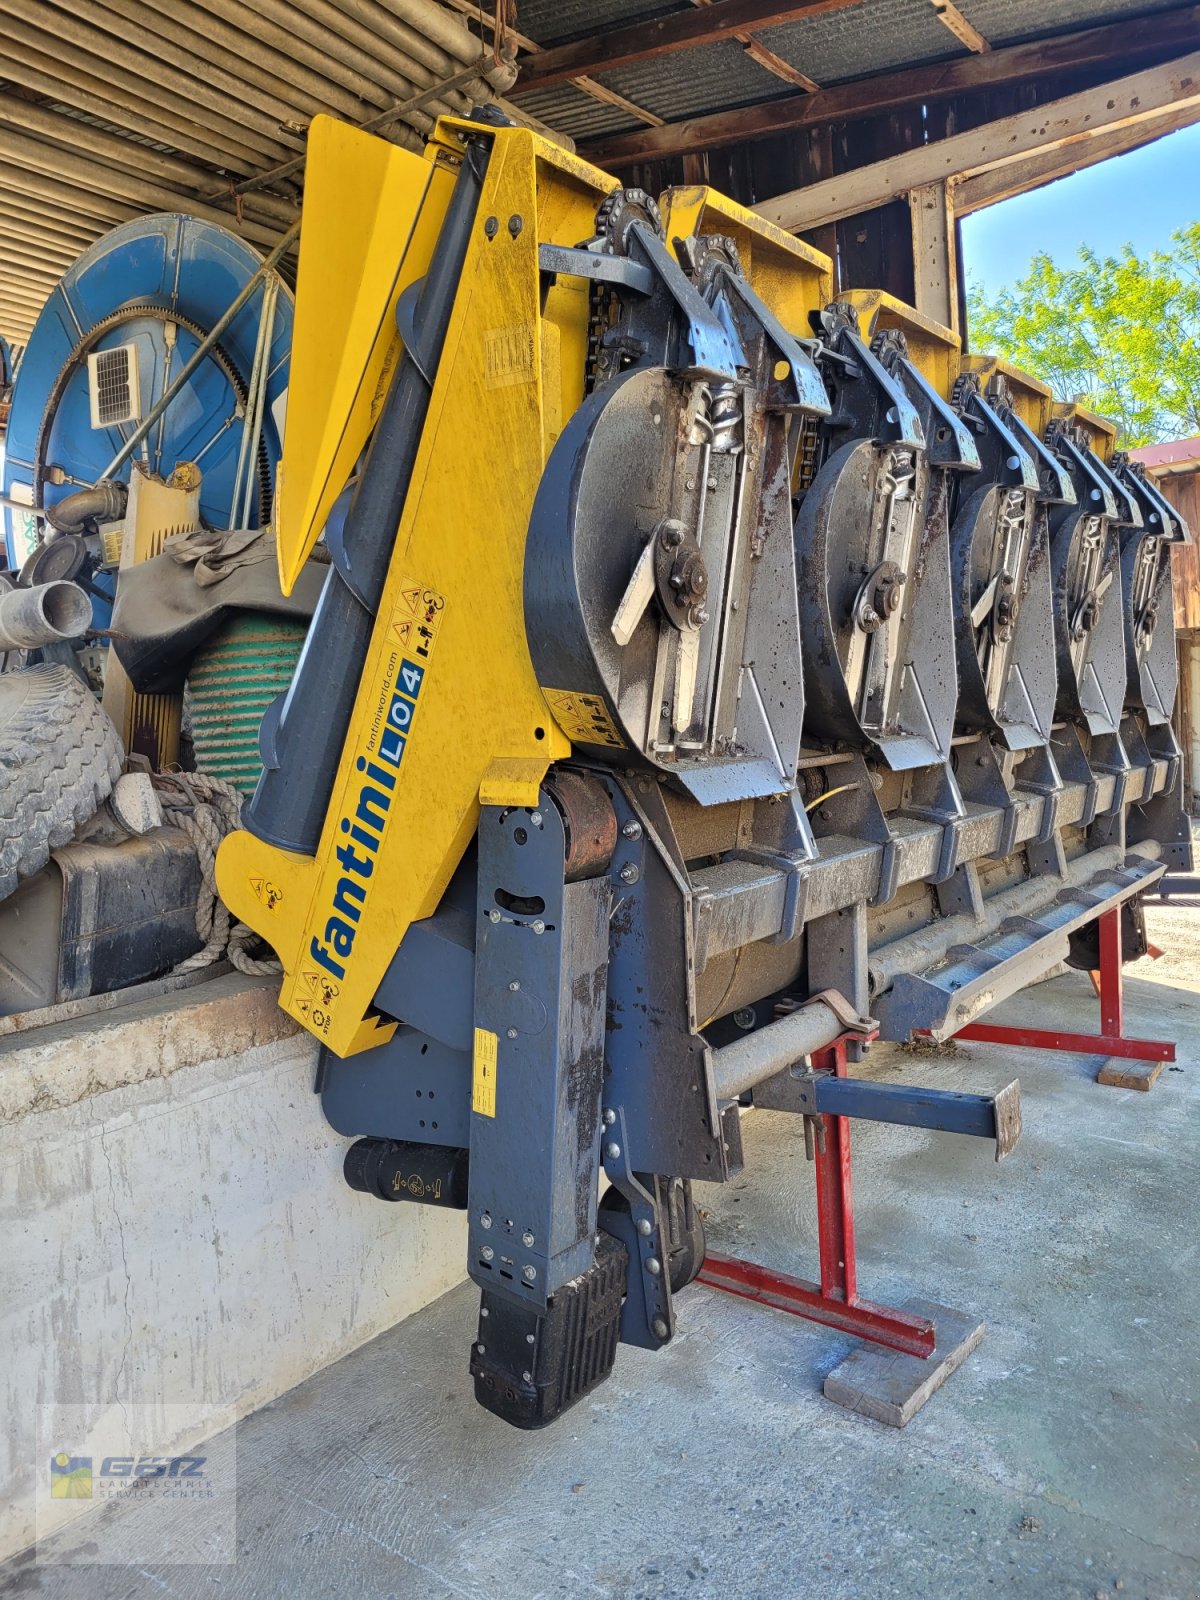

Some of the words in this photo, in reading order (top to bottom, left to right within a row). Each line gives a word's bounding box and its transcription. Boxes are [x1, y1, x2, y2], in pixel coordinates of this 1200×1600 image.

[366, 652, 398, 752] fantiniworld.com
[310, 755, 397, 981] fantini
[322, 1015, 331, 1035] STOP
